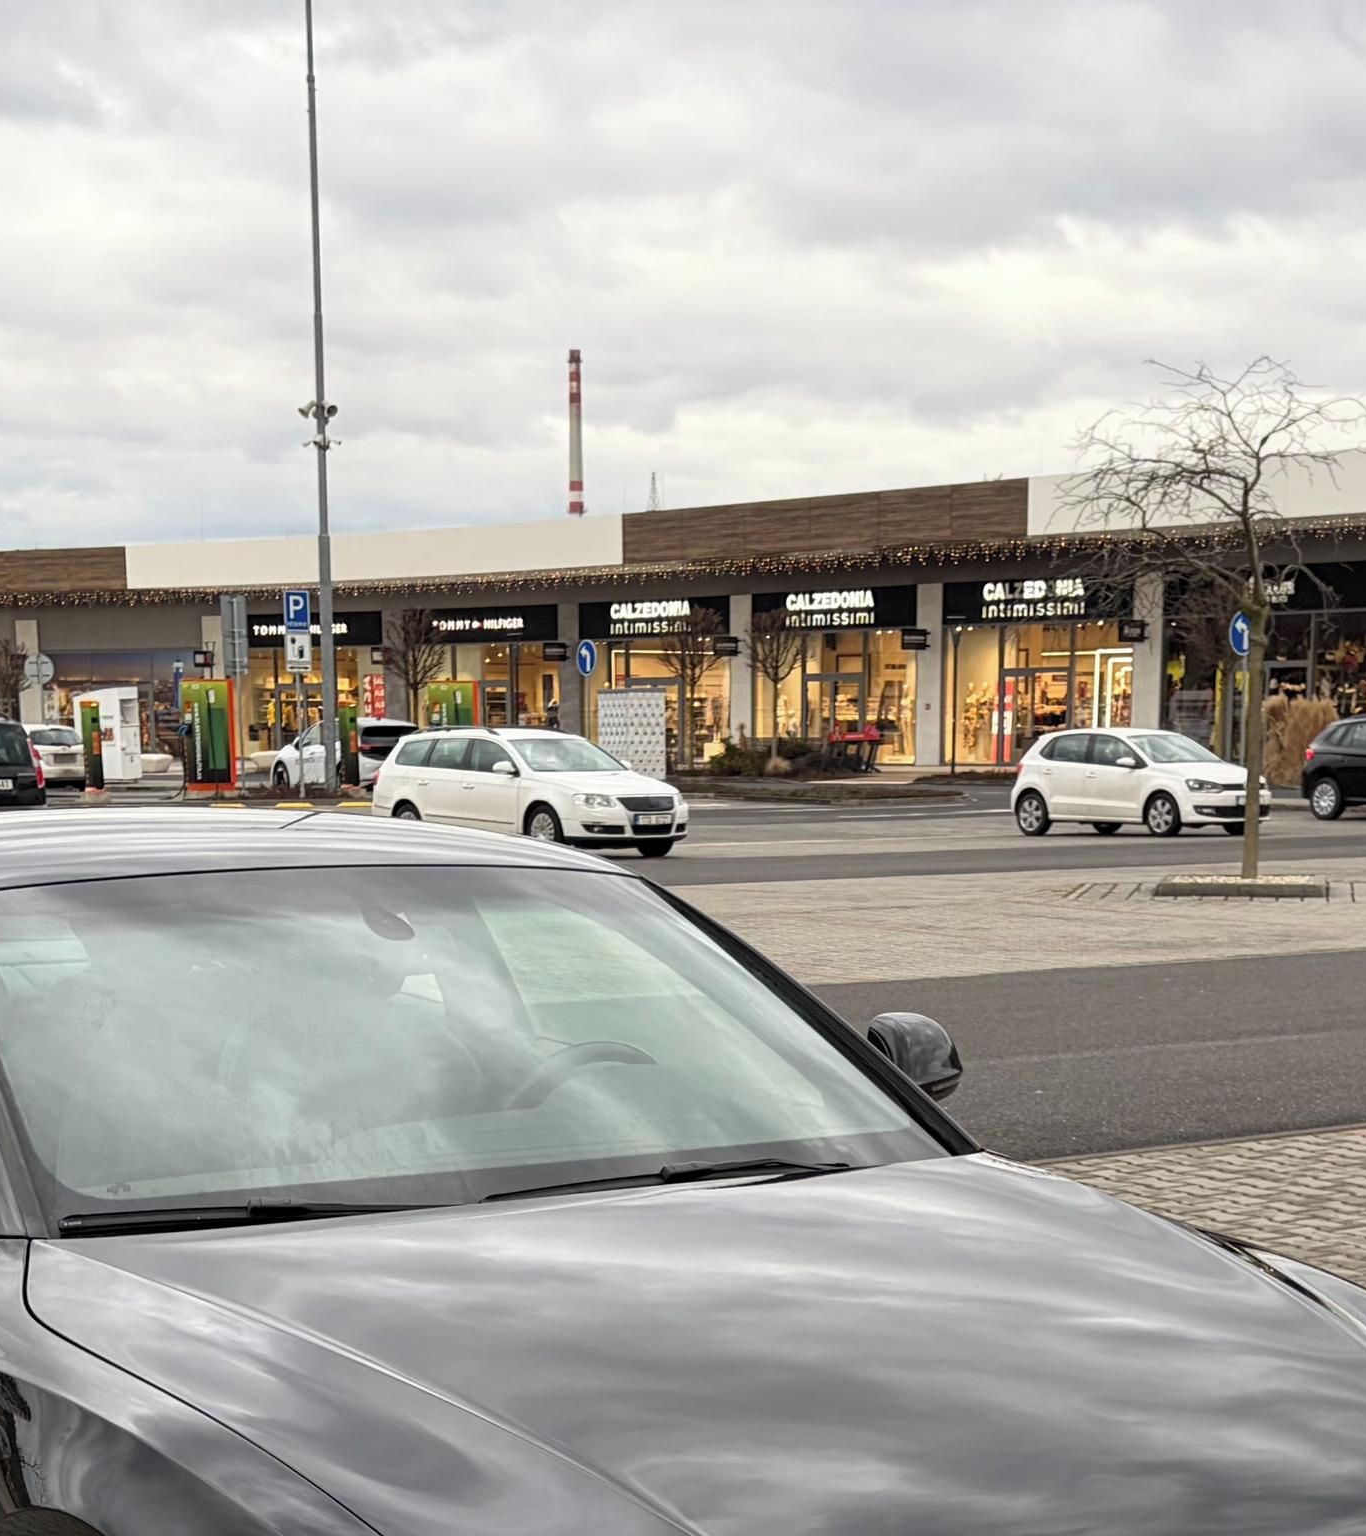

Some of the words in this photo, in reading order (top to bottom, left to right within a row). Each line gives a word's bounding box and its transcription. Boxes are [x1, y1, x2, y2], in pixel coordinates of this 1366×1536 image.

[288, 595, 305, 620] P
[785, 589, 875, 612] CALZEDONIA
[610, 600, 691, 620] CALZEDONIA
[981, 602, 1086, 619] intimissimi
[483, 617, 524, 631] HILFIGER
[785, 611, 875, 628] intimissimi
[252, 624, 287, 636] TOMM
[308, 622, 348, 635] HILGER
